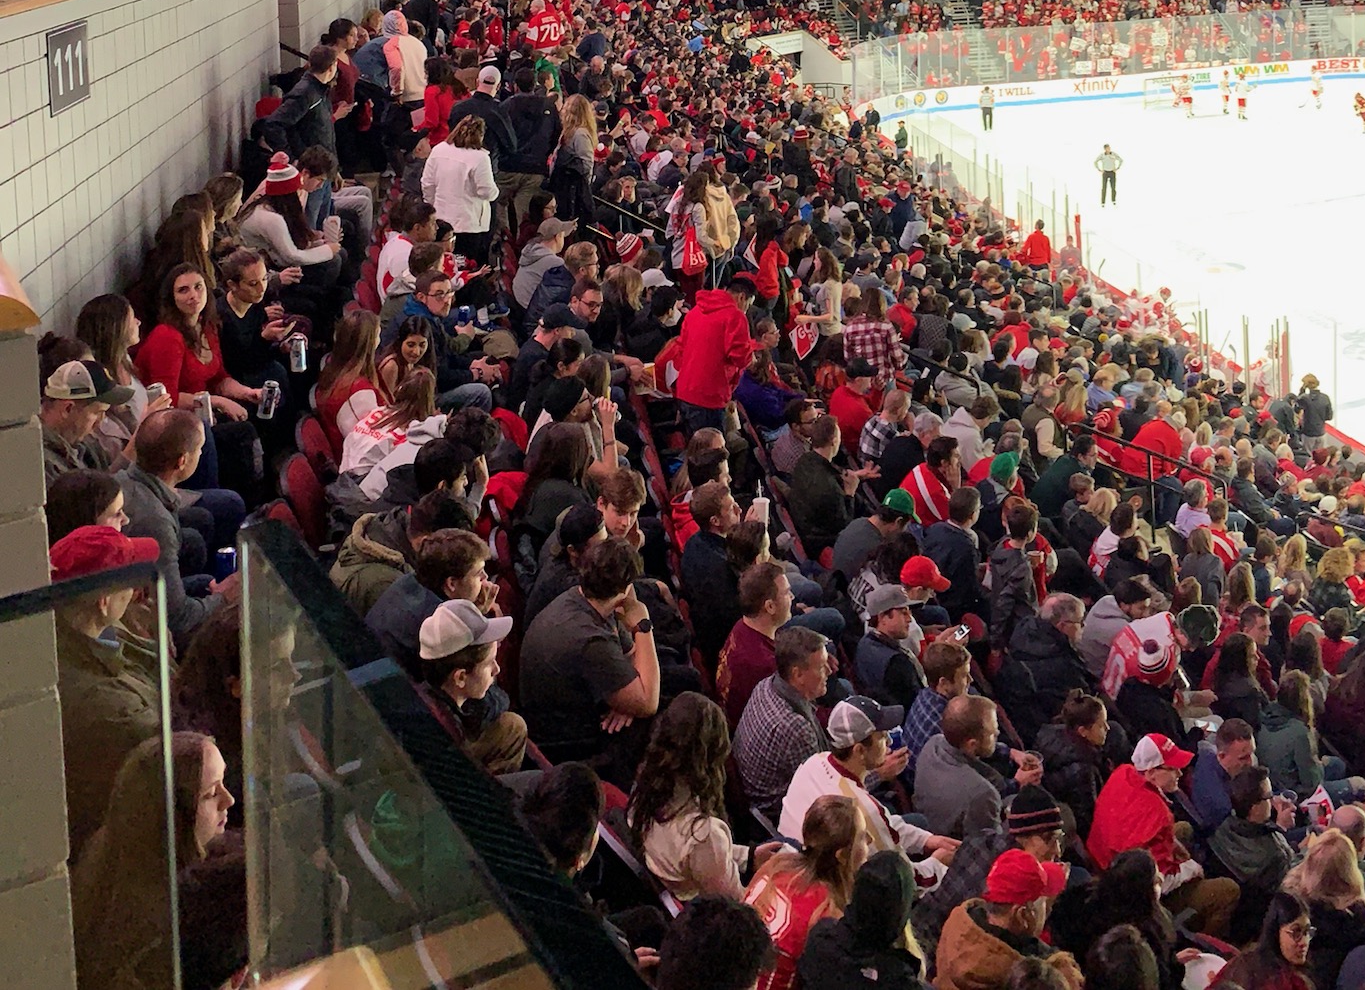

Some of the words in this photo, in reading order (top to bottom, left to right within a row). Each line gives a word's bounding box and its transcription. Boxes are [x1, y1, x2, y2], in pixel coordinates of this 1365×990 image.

[540, 23, 560, 42] 70
[54, 40, 84, 96] 111
[1234, 65, 1258, 75] WM
[1264, 64, 1289, 73] WM
[1317, 59, 1360, 70] BEST
[1073, 77, 1119, 95] xfinity
